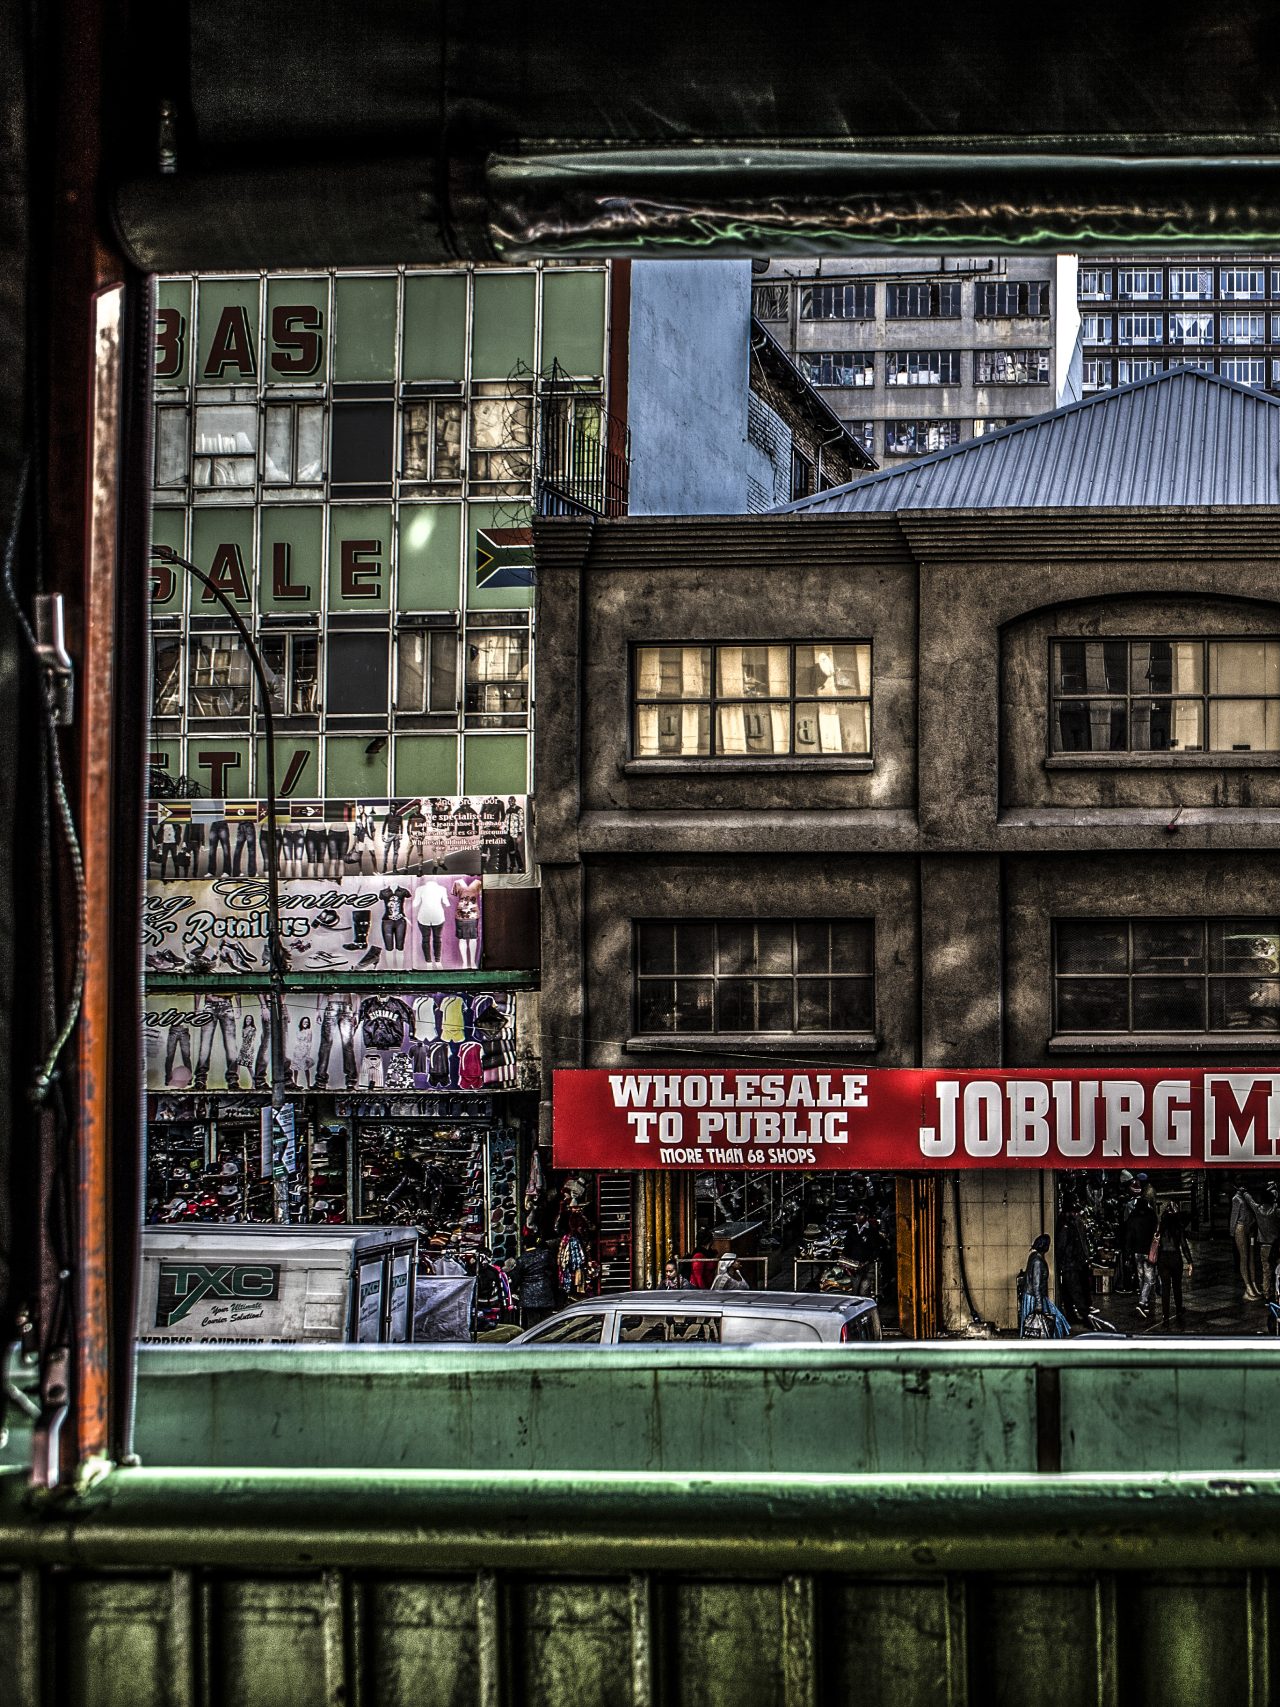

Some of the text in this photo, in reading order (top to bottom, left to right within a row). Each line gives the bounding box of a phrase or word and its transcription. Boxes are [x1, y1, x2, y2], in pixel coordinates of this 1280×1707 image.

[183, 910, 311, 947] Retailrs
[608, 1075, 868, 1107] WHOLESALE
[627, 1112, 848, 1144] TO PUBLIC
[919, 1080, 1191, 1157] JOBURG
[660, 1148, 816, 1164] MORE THAN 68 SHOPS
[161, 1265, 274, 1311] TXC
[361, 1281, 380, 1297] TXC
[201, 1310, 264, 1327] Courier Solution!
[211, 1302, 263, 1317] Your Ultimate
